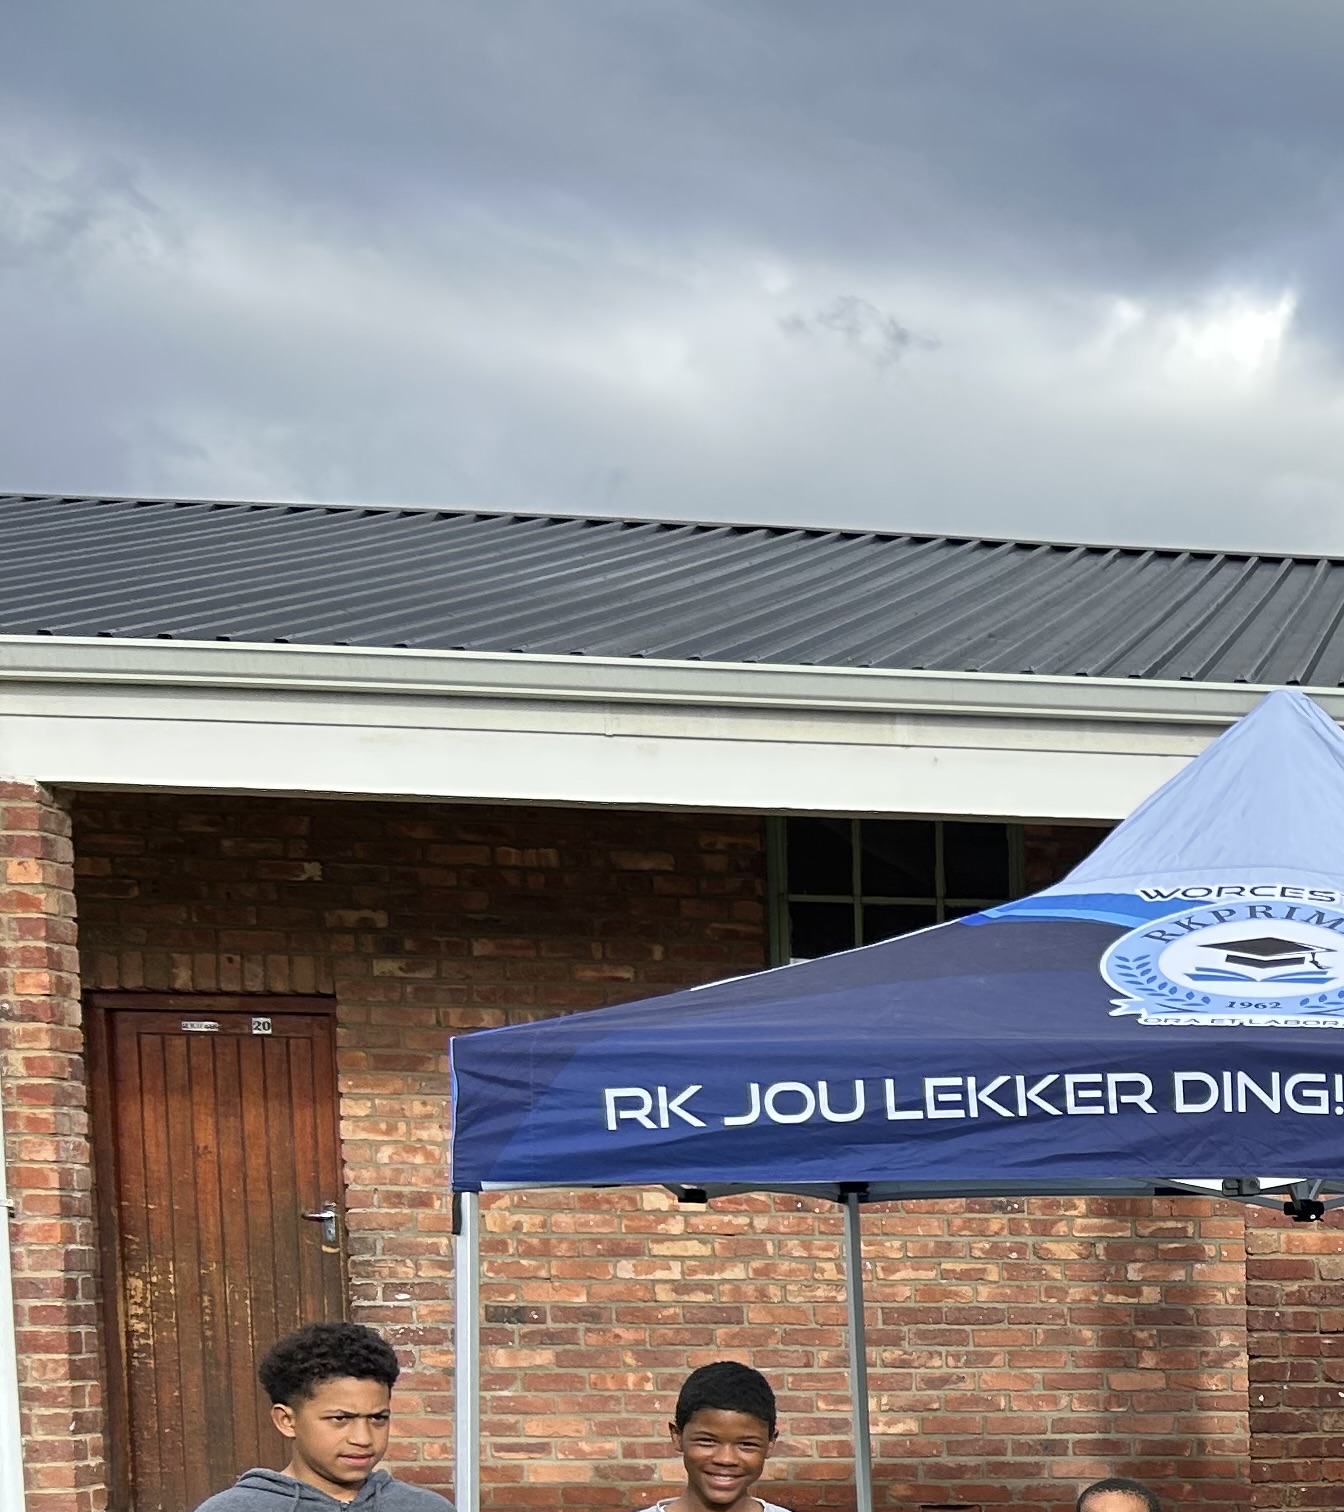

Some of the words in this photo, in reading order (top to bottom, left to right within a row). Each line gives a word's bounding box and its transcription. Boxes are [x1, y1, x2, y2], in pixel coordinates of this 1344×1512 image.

[1226, 1000, 1283, 1010] 1962
[252, 1020, 271, 1031] 20
[604, 1084, 707, 1131] RK
[723, 1079, 865, 1126] JOU
[884, 1071, 1158, 1121] LEKKER
[1173, 1071, 1344, 1116] DING!
